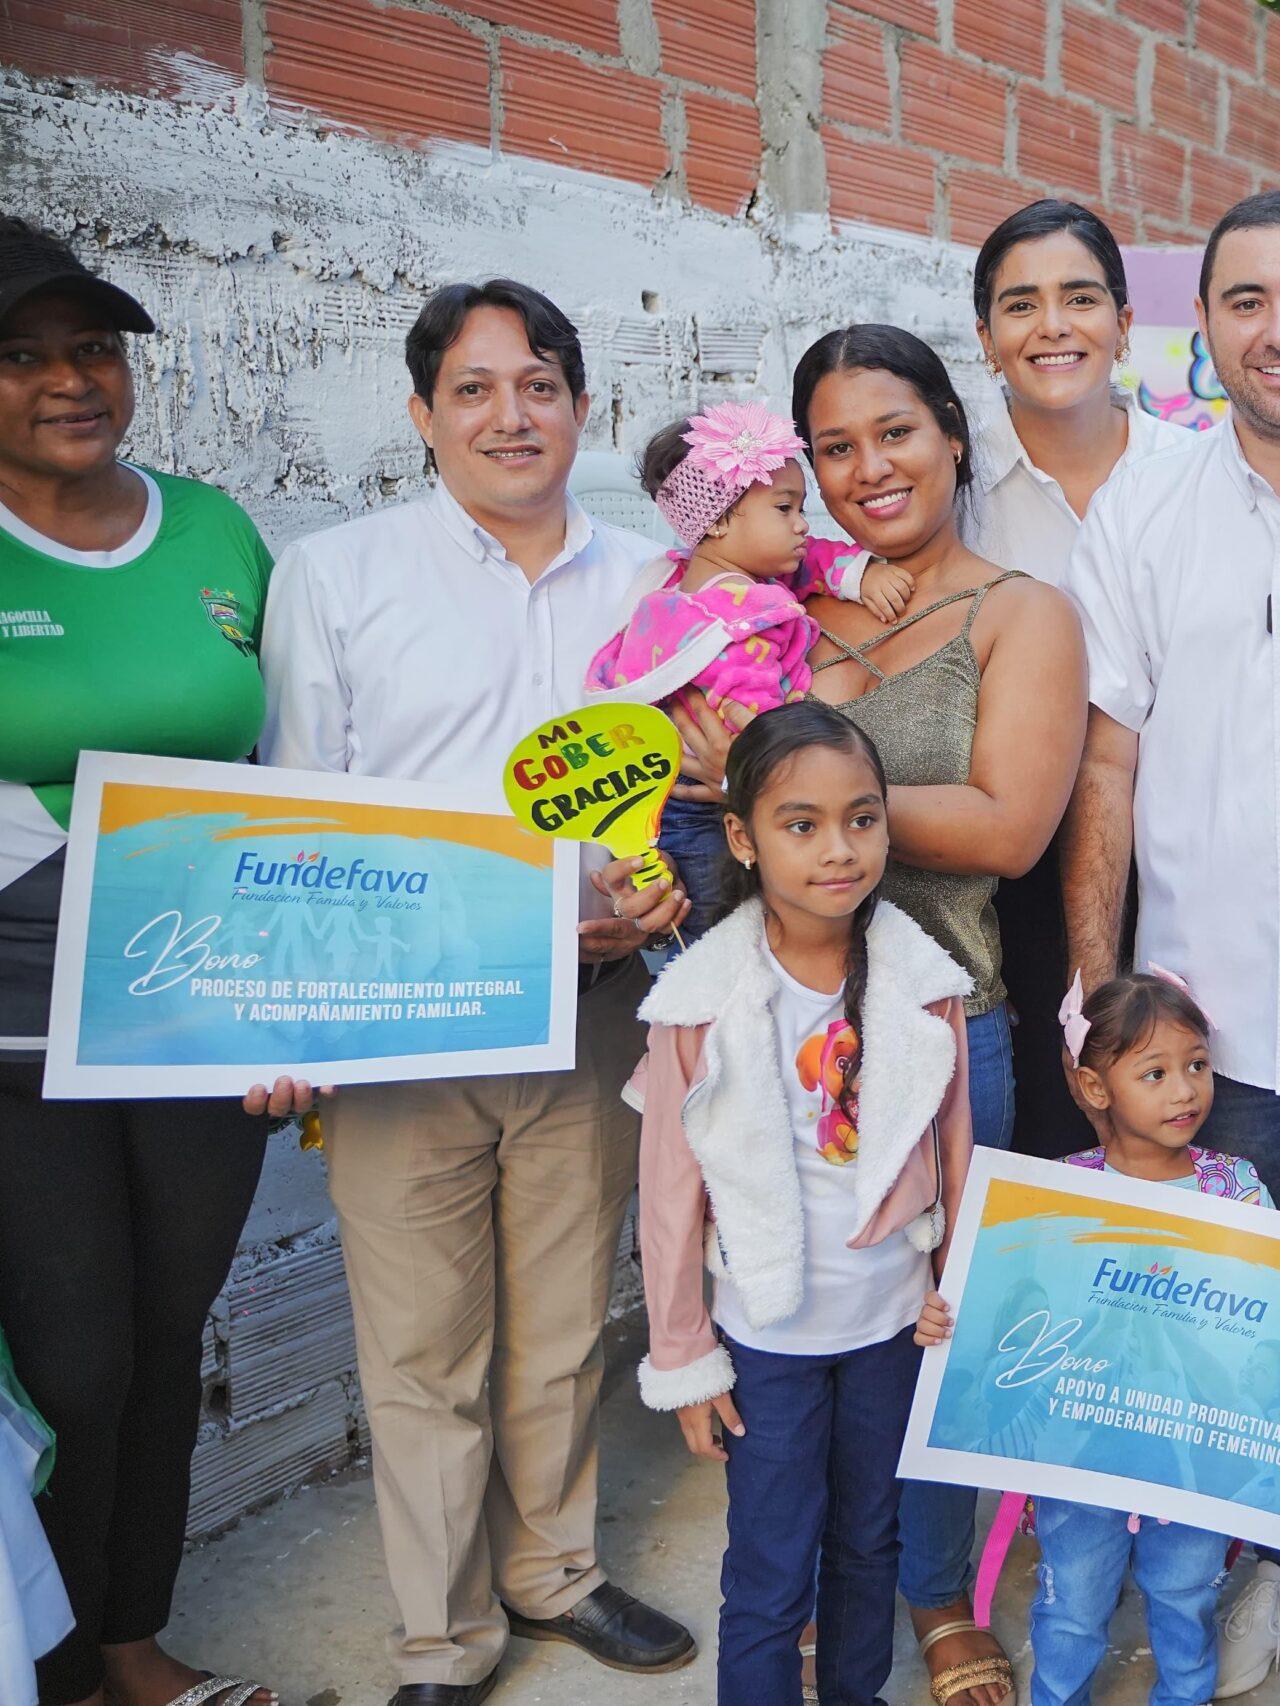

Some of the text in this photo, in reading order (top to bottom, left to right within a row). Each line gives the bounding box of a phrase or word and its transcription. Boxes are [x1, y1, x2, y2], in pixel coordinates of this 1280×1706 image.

[1, 624, 65, 637] Y LIBERTAD
[537, 720, 583, 749] MI
[513, 724, 645, 791] GOBER
[531, 752, 672, 832] GRACIAS
[234, 850, 429, 895] Fundefava
[306, 891, 356, 907] Familia
[357, 899, 369, 912] y
[375, 895, 423, 911] Valores
[123, 910, 263, 996] Bono
[190, 977, 525, 1000] PROCESO DE FORTALECIMIENTO INTEGRAL
[233, 1001, 487, 1022] Y ACOMPAÑAMIENTO FAMILIAR.
[1092, 1258, 1268, 1323] Fundefava
[1151, 1303, 1198, 1325] Familia
[1199, 1319, 1209, 1331] y
[1213, 1316, 1257, 1339] Valores
[995, 1309, 1113, 1389] Bono
[1054, 1376, 1106, 1401] APOYO
[1109, 1386, 1120, 1405] A
[1125, 1388, 1184, 1418] UNIDAD
[1048, 1397, 1059, 1416] Y
[1061, 1400, 1205, 1446] EMPODERAMIENTO
